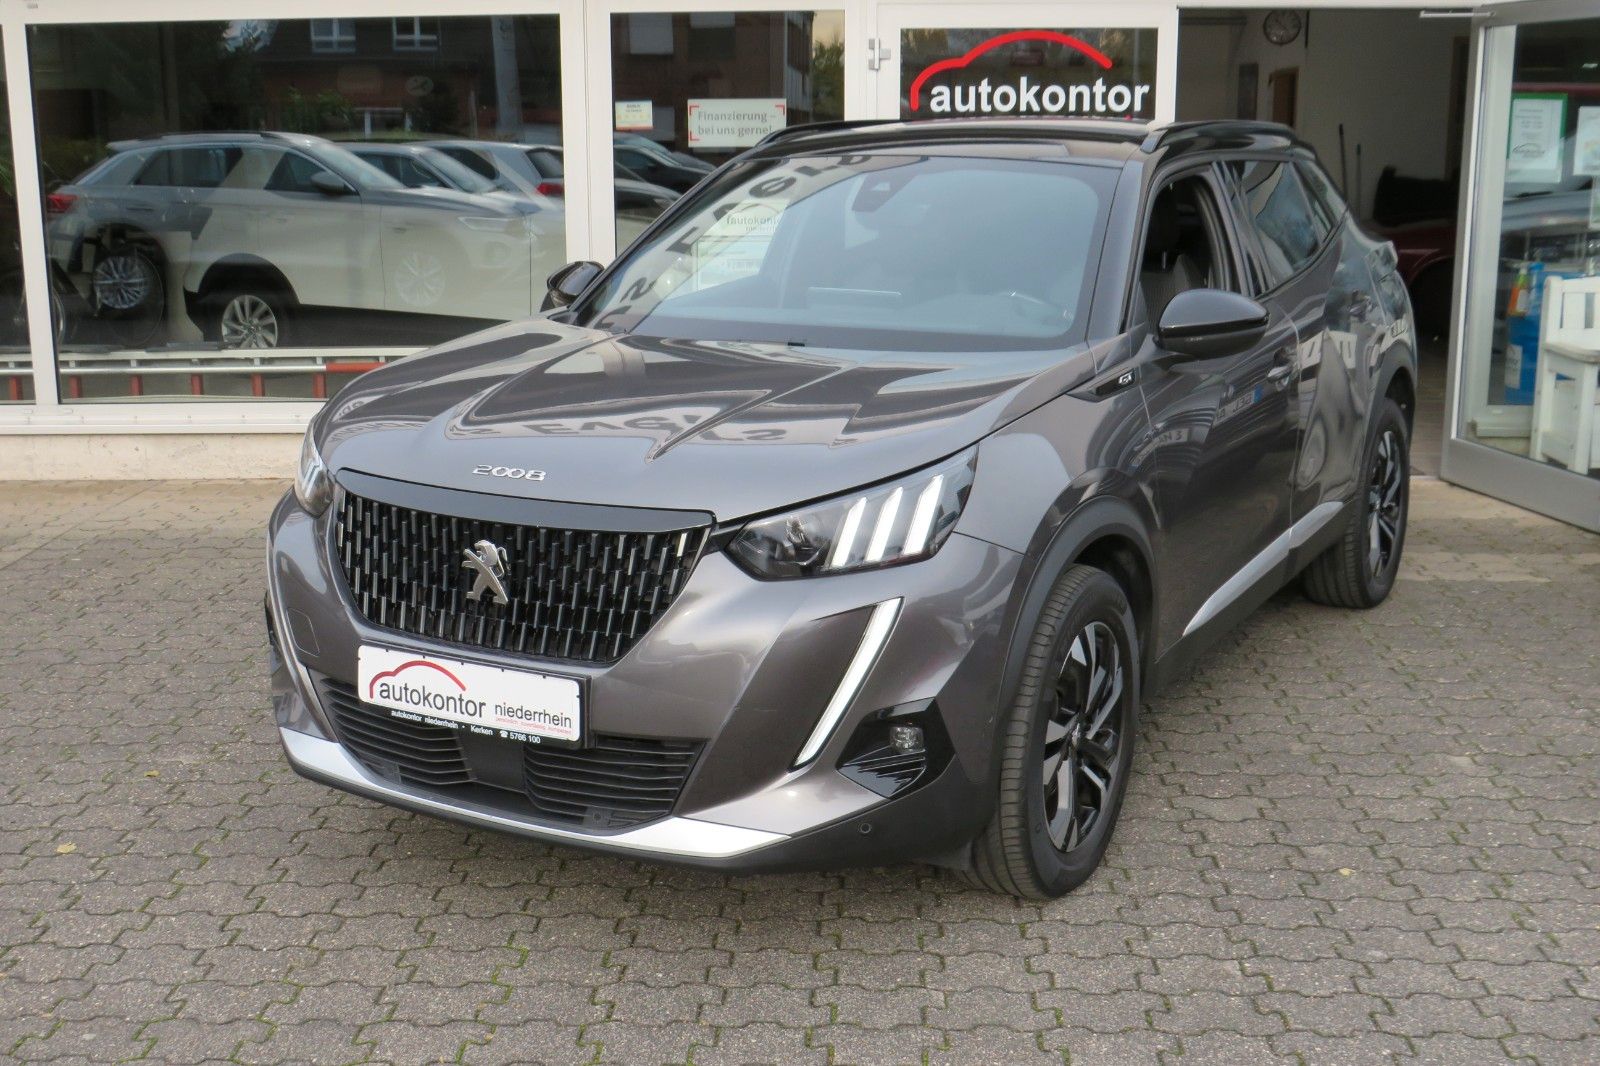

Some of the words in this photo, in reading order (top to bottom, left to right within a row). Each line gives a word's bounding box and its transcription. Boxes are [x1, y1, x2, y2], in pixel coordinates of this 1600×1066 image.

[930, 76, 1150, 113] autokontor
[698, 111, 768, 122] Finanzierung
[698, 125, 713, 135] bei
[717, 126, 736, 135] uns
[738, 125, 772, 137] gerne!
[472, 464, 547, 481] 2008
[379, 682, 486, 718] autokontor
[495, 702, 572, 729] niederrhein
[391, 709, 423, 722] autokontor
[425, 716, 459, 729] niederrhein
[470, 724, 493, 736] Kerken
[528, 735, 541, 744] 100
